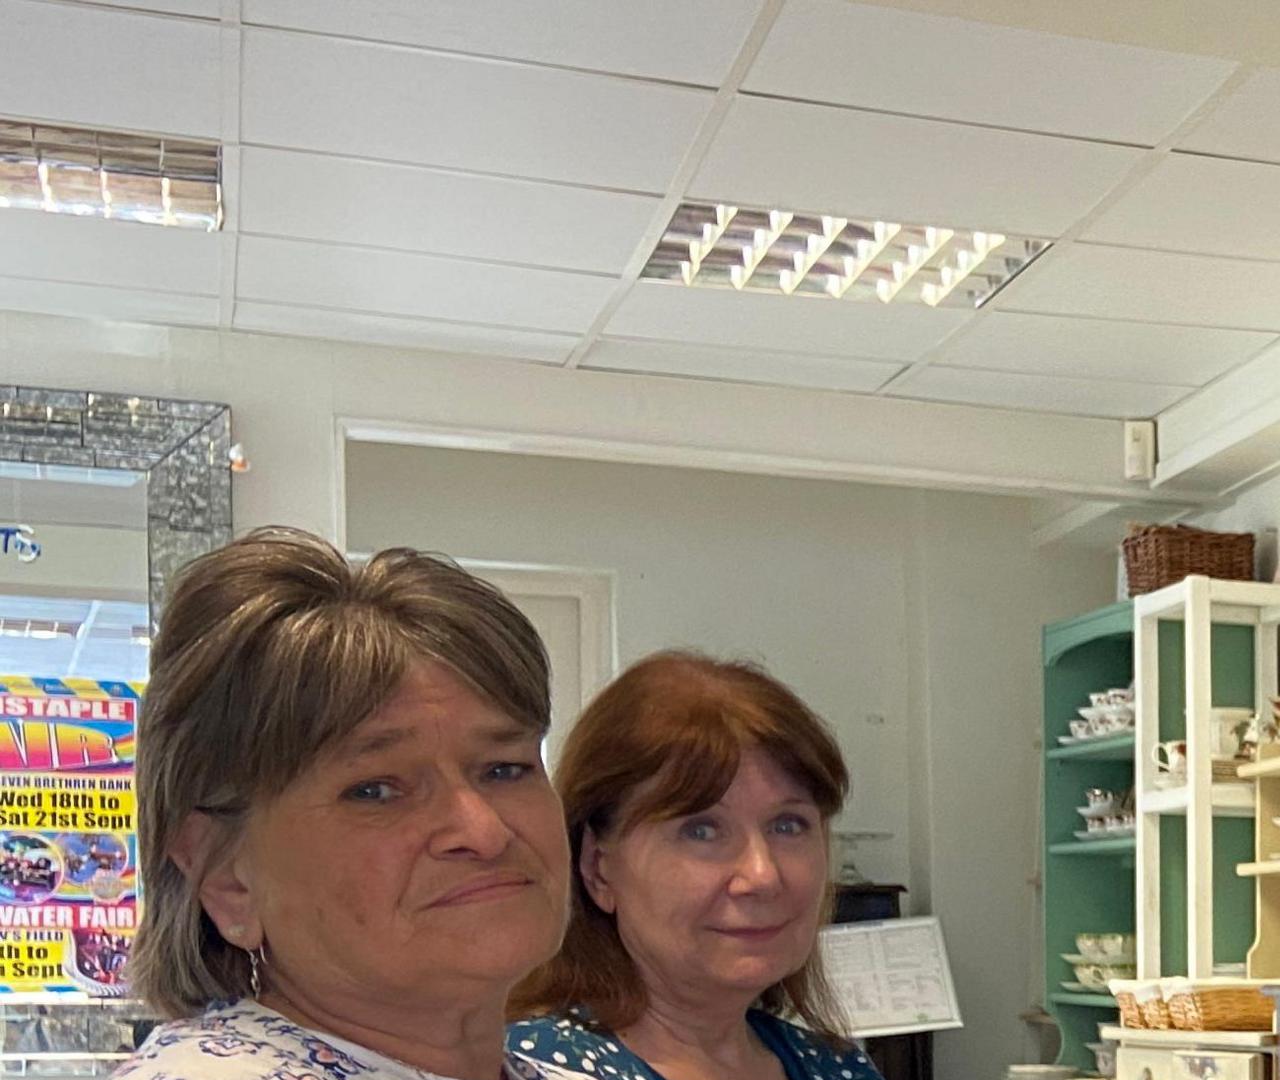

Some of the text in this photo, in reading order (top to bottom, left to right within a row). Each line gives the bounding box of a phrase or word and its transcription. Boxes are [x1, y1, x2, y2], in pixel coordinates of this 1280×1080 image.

[99, 779, 132, 791] BANK
[50, 792, 94, 809] 18th
[100, 795, 120, 810] to
[35, 811, 78, 827] 21st
[84, 813, 132, 830] Sept
[80, 906, 134, 929] FAIR
[27, 945, 49, 959] to
[12, 962, 62, 979] Sept
